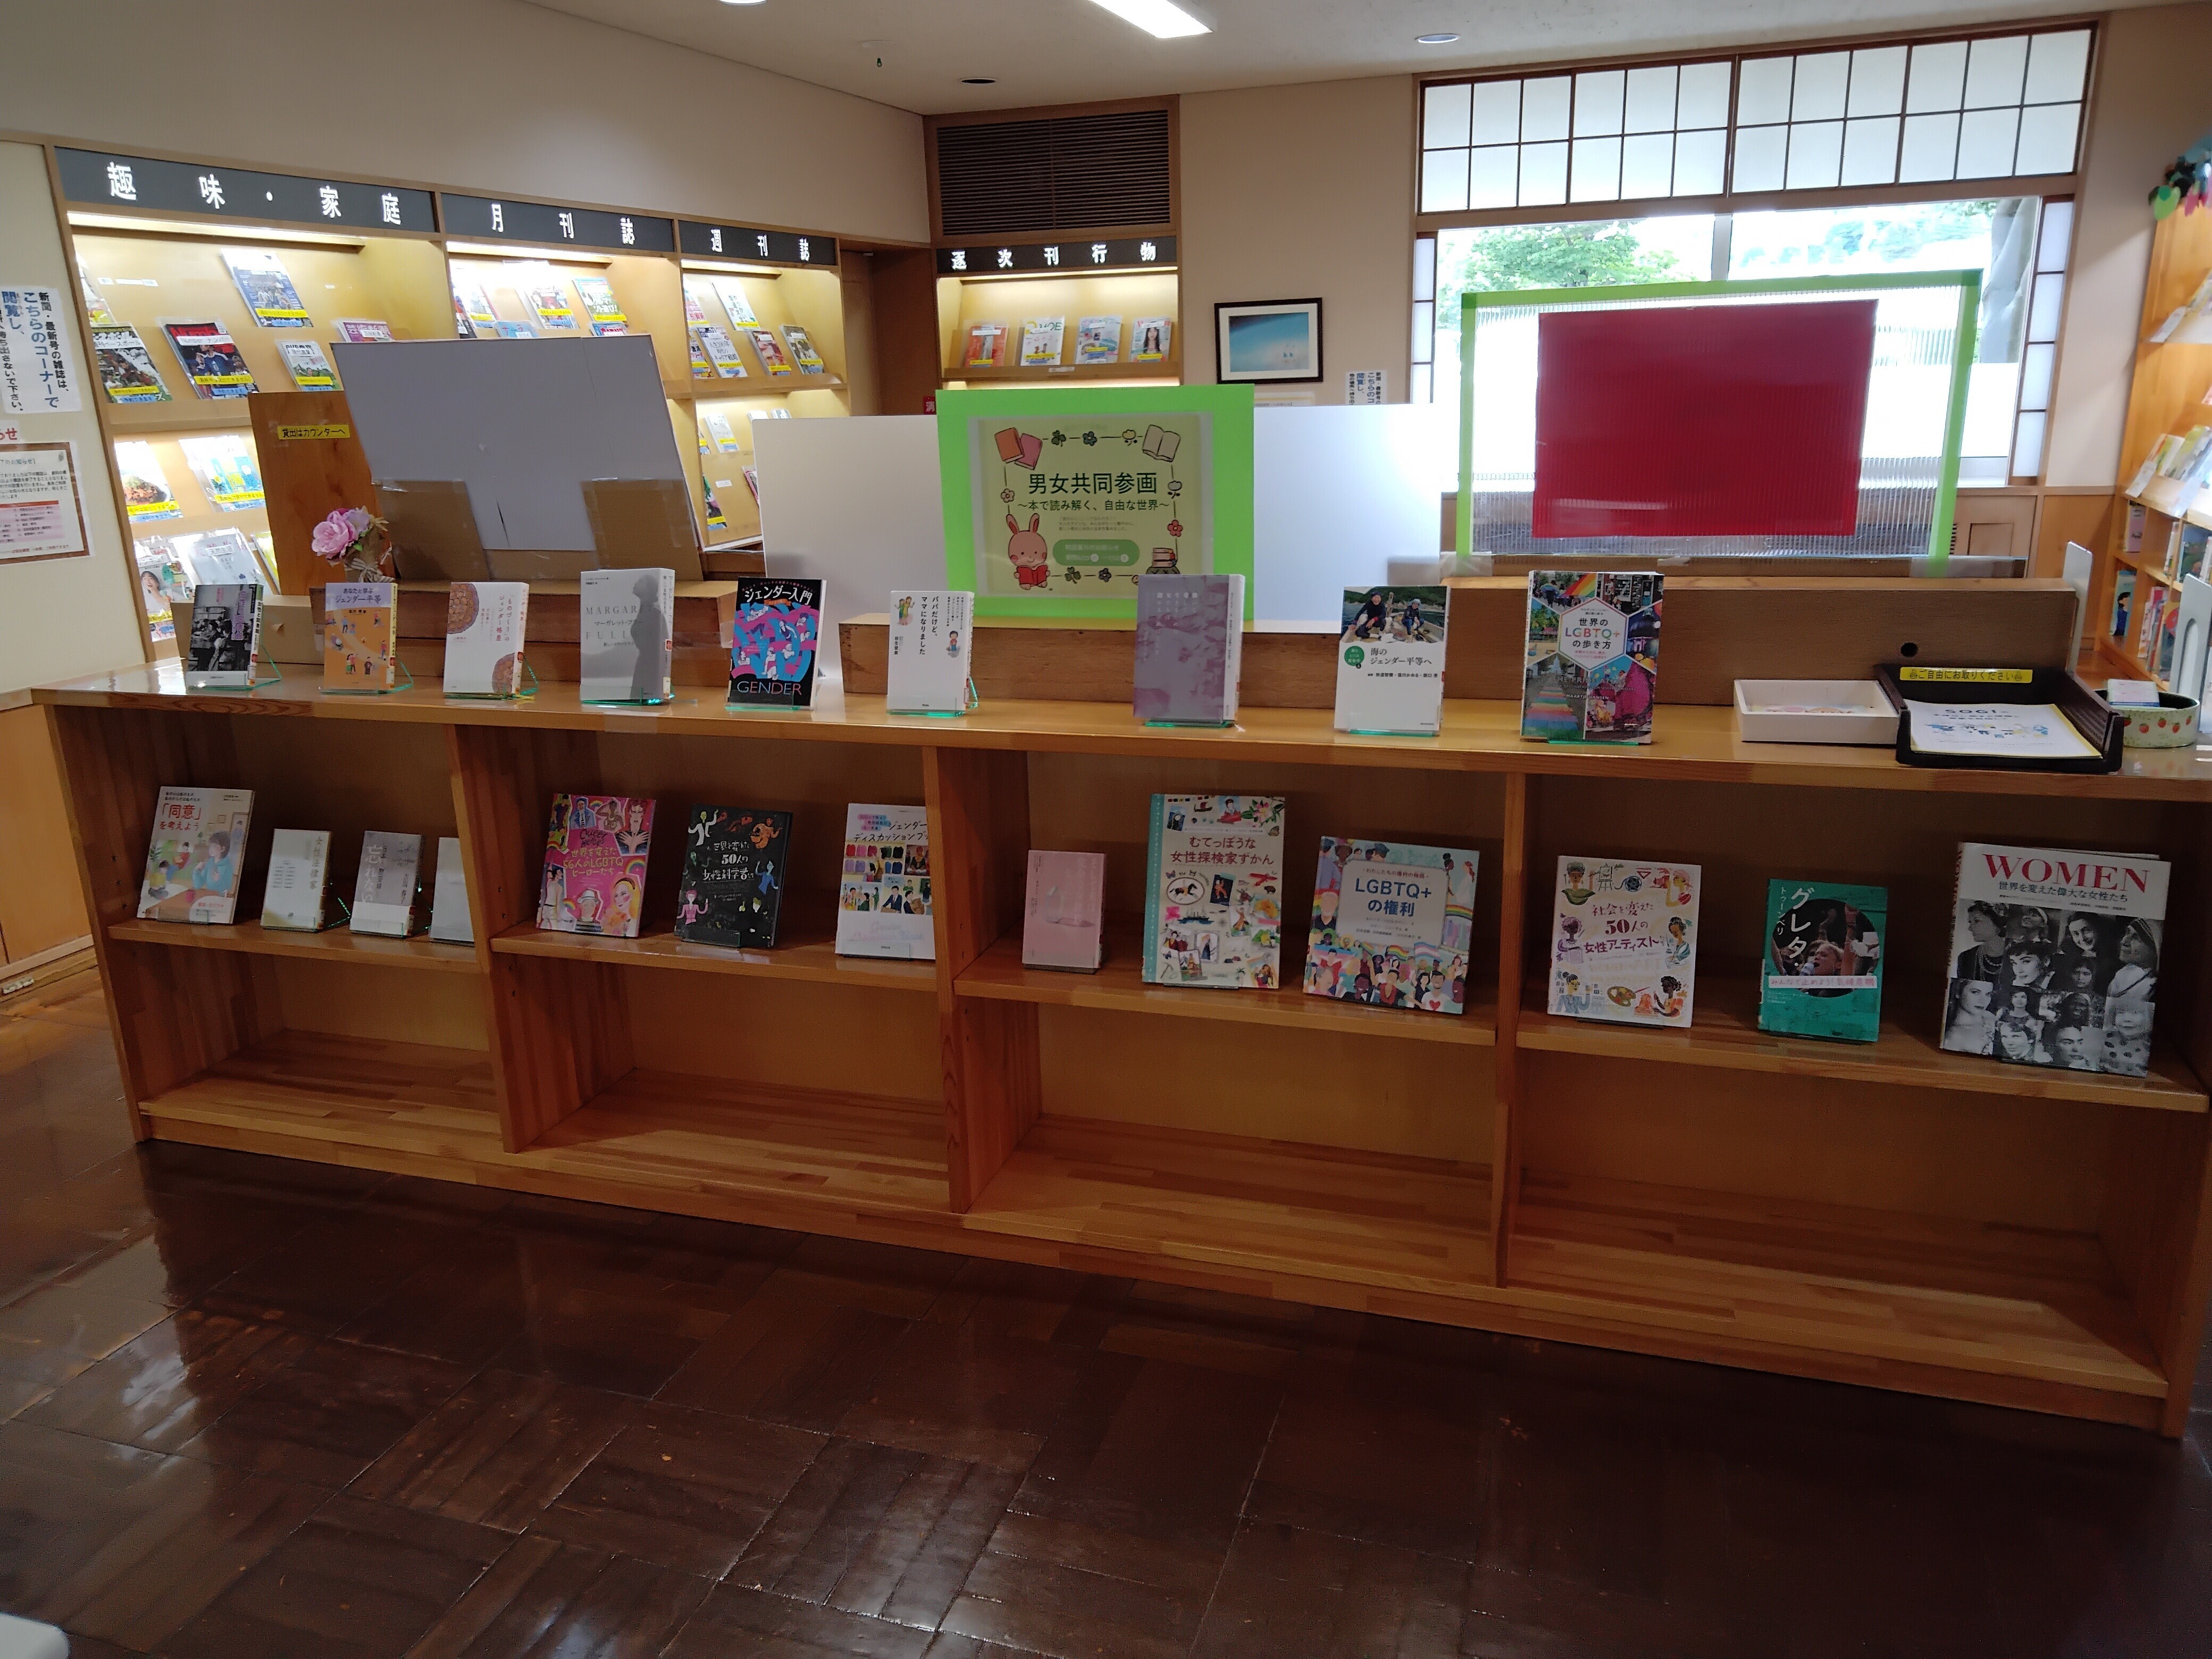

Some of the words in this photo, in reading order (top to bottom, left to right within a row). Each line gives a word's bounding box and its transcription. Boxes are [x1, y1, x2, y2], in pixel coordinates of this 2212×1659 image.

[107, 161, 403, 225] 趣味・家庭
[490, 203, 636, 245] 月刊誌
[710, 229, 811, 262] 週刊誌
[951, 241, 1157, 270] 逐次刊行物
[23, 292, 60, 408] こちらのコーナーで
[281, 427, 346, 438] 貸出はカウンターへ
[1028, 472, 1157, 495] 男女共同参画
[334, 594, 382, 604] ジェンダー平等
[744, 584, 813, 606] ジェンダー入門
[496, 594, 505, 641] ジェンダー格差
[931, 596, 940, 636] パパだけど、
[1579, 617, 1608, 626] 世界の
[919, 596, 928, 656] ママになりました
[1565, 627, 1621, 640] LGBTQ+
[1370, 647, 1387, 656] 海の
[1572, 640, 1611, 650] の歩き方
[1370, 656, 1432, 666] ジェンダー平等へ
[1918, 669, 2015, 681] ご自由にお取りください
[736, 681, 802, 696] GENDER
[162, 803, 202, 820] 「同意」
[160, 821, 199, 831] を考えよう
[889, 820, 927, 831] ジェンダー
[1189, 835, 1256, 849] むてっぽうな
[721, 853, 749, 865] 50人の
[1170, 851, 1275, 865] 女性探検家ずかん
[1982, 853, 2151, 893] WOMEN
[1355, 877, 1432, 899] LGBTQ+
[1999, 881, 2129, 903] 世界を変えた偉大な女性たち
[1368, 899, 1415, 917] の権利
[1592, 901, 1654, 917] 社会を変えた
[1604, 919, 1649, 935] 50人の
